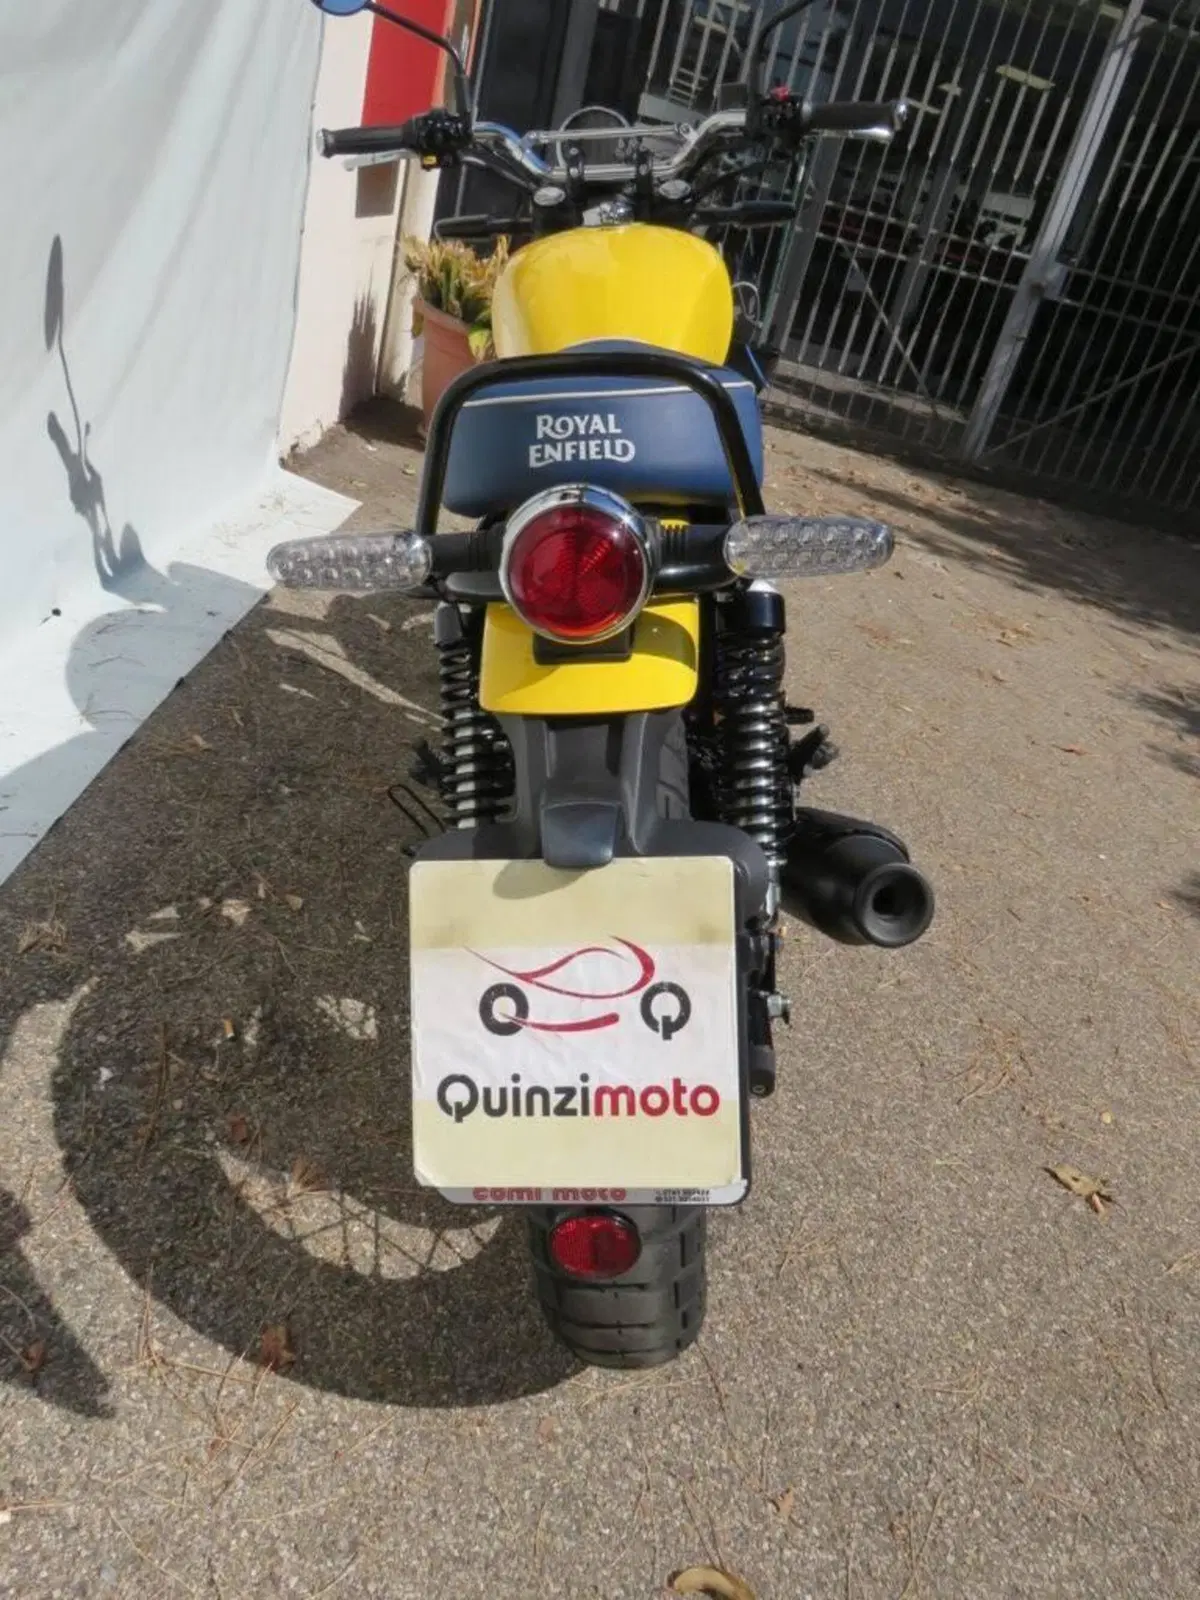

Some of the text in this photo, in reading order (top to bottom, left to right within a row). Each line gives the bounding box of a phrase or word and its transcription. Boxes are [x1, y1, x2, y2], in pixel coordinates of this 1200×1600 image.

[536, 413, 622, 440] ROYAL
[528, 439, 636, 469] ENFIELD
[436, 1072, 721, 1124] Quinzimoto
